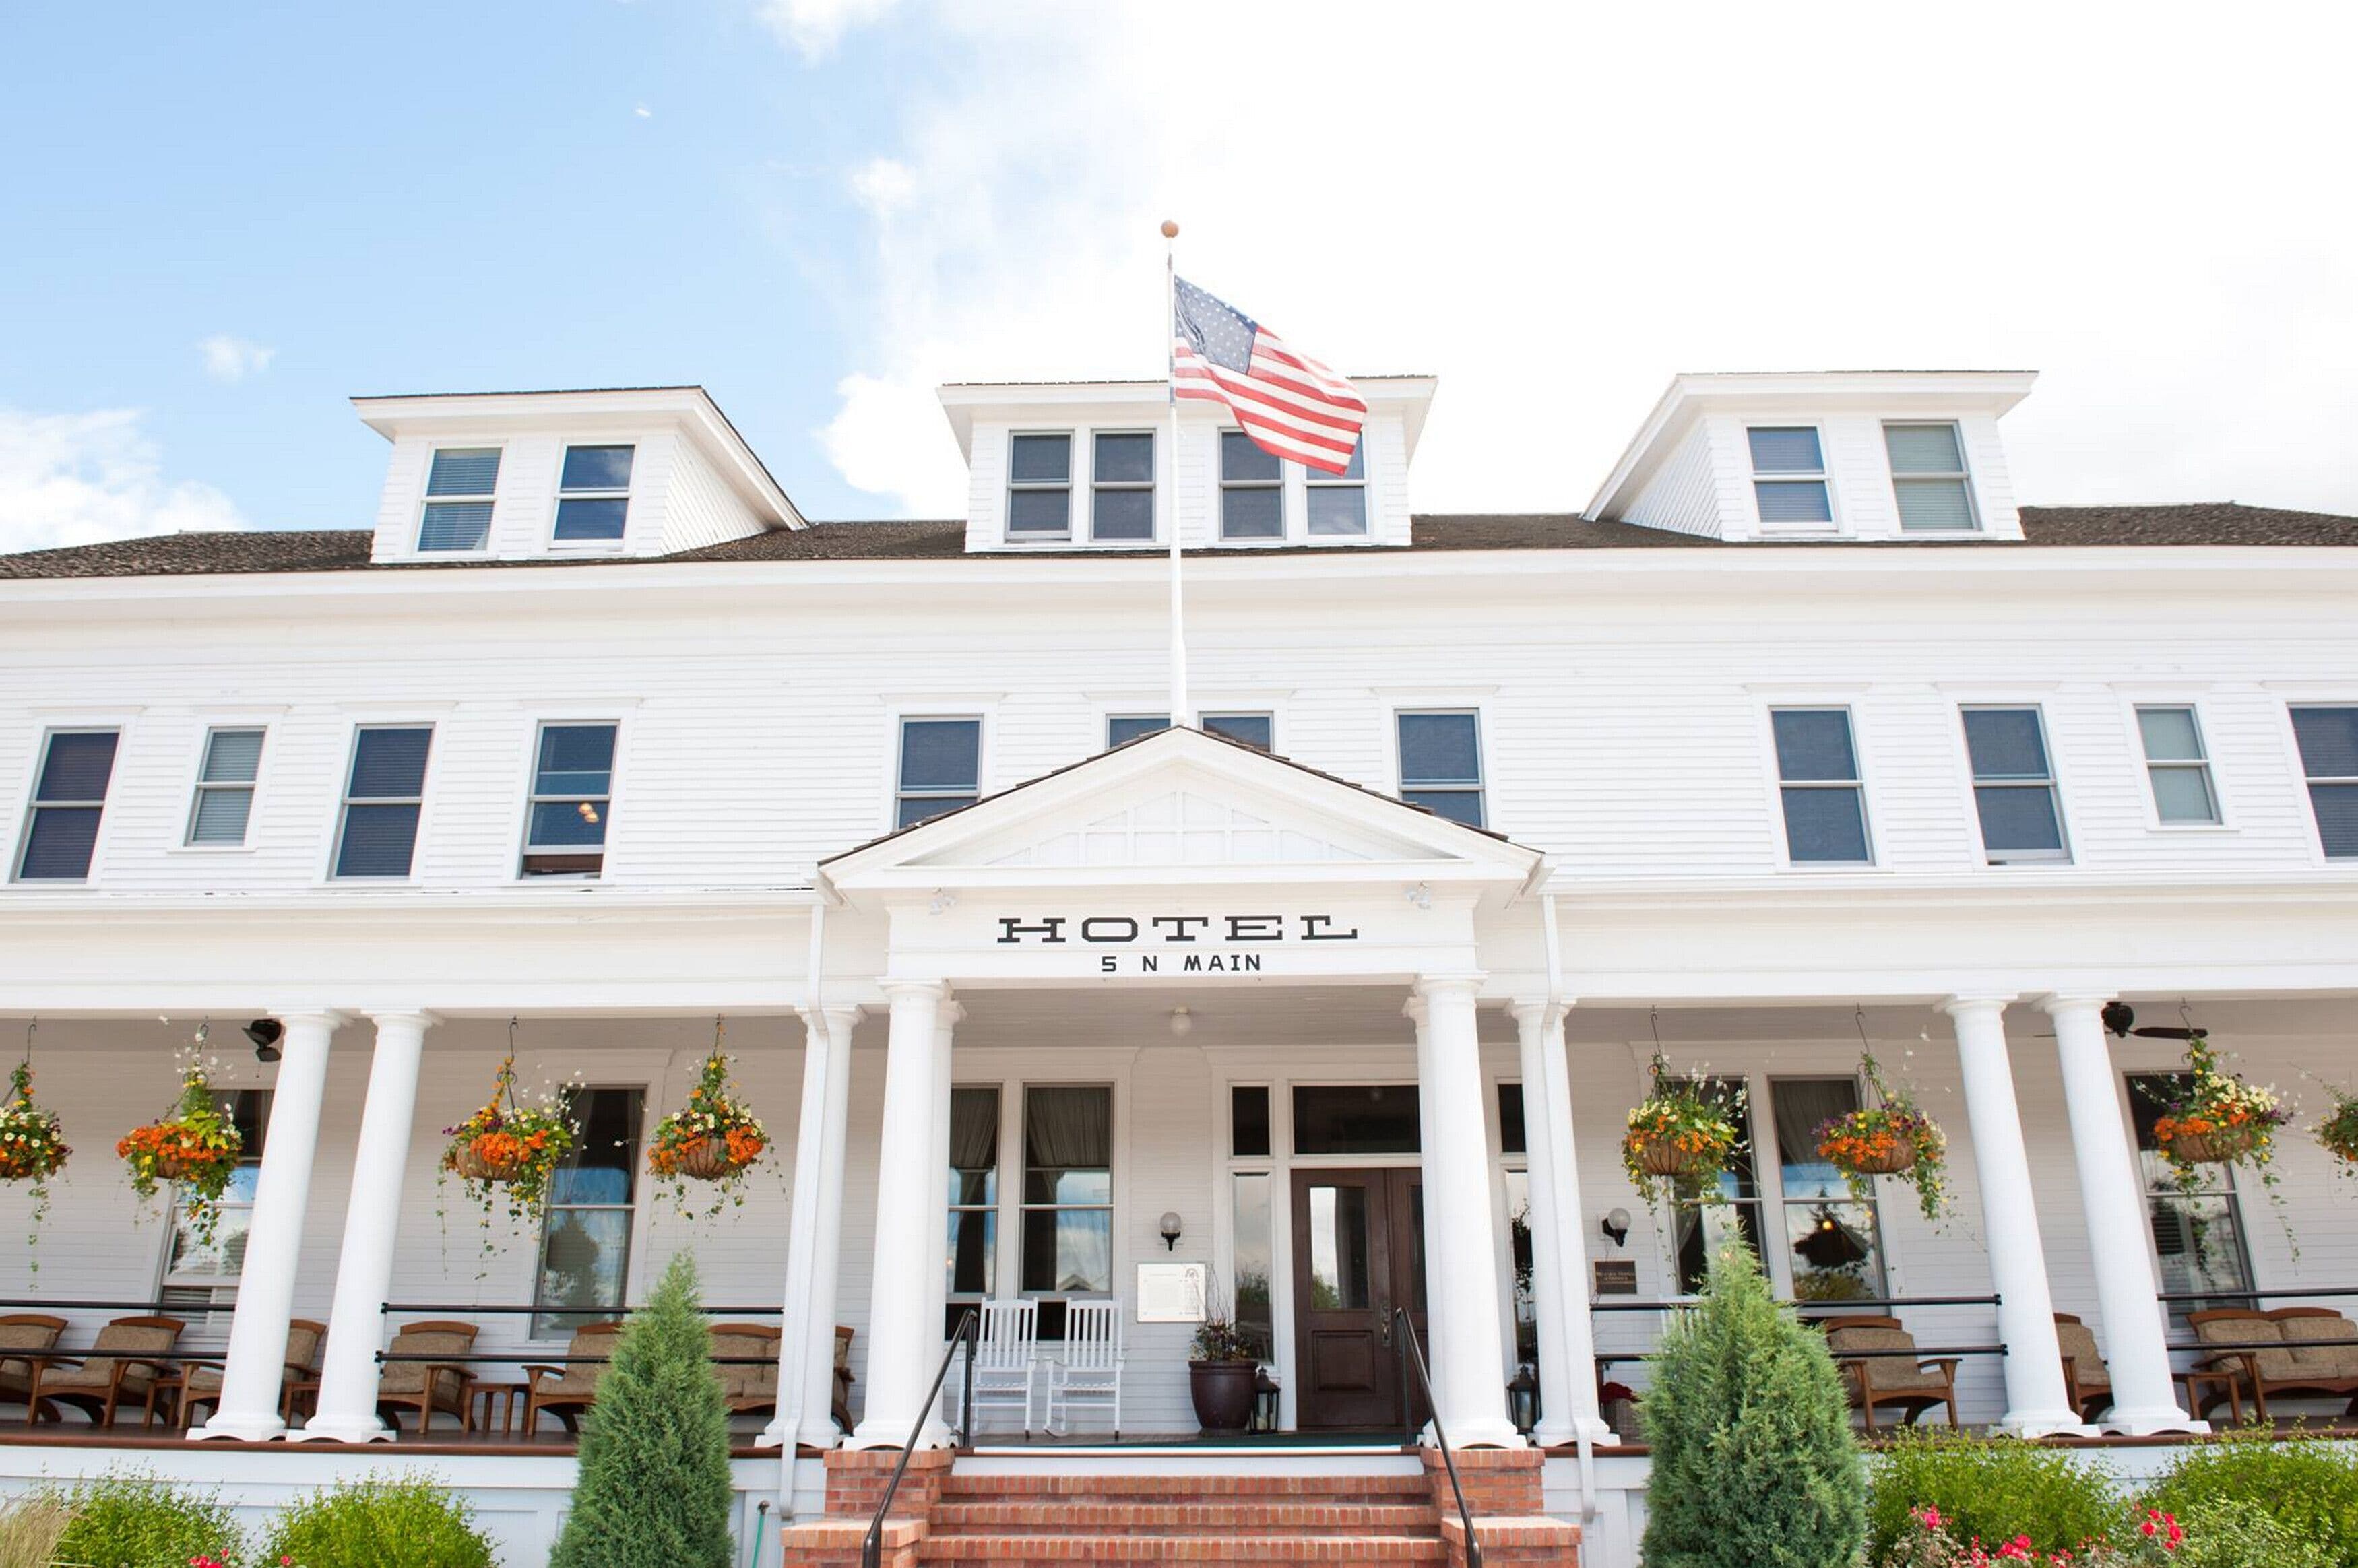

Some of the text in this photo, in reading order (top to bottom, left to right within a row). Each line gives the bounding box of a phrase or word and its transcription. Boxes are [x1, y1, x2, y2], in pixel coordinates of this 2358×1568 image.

[997, 915, 1358, 943] HOTEL
[1143, 955, 1157, 972] N
[1184, 954, 1261, 971] MAIN
